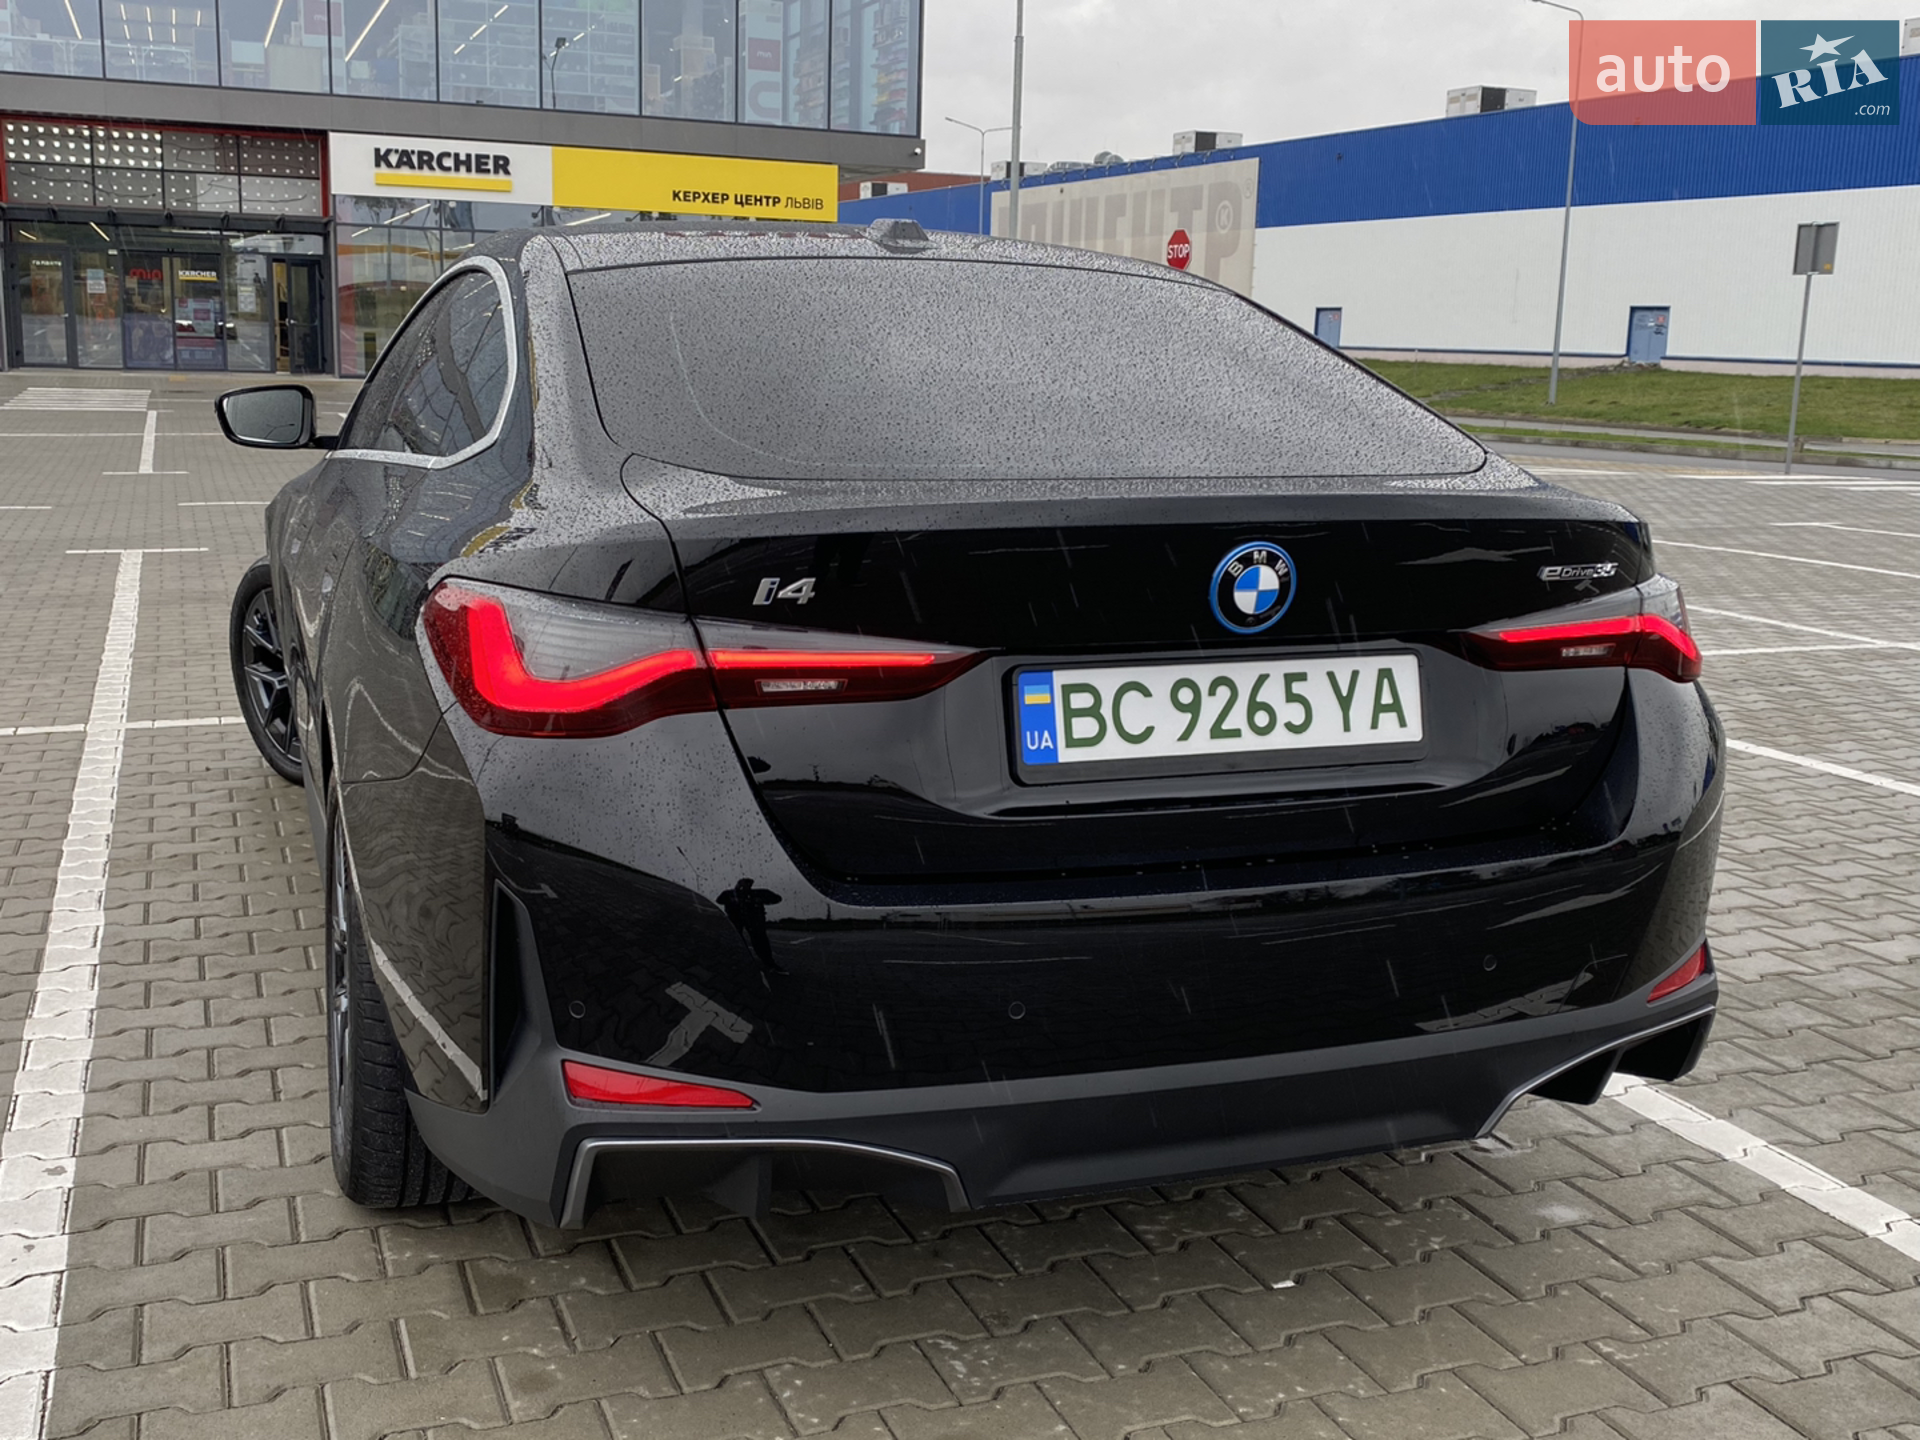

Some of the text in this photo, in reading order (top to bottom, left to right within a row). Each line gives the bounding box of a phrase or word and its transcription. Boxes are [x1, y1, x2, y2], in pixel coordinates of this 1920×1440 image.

[374, 147, 511, 176] KÄRCHER
[672, 190, 824, 210] КЕРХЕР ЦЕНТР ЛЬВІВ
[1167, 243, 1190, 259] STOP
[1227, 550, 1289, 578] BMW
[752, 577, 816, 605] i4
[1061, 667, 1408, 748] BC 9265 YA
[1026, 729, 1054, 751] UA
